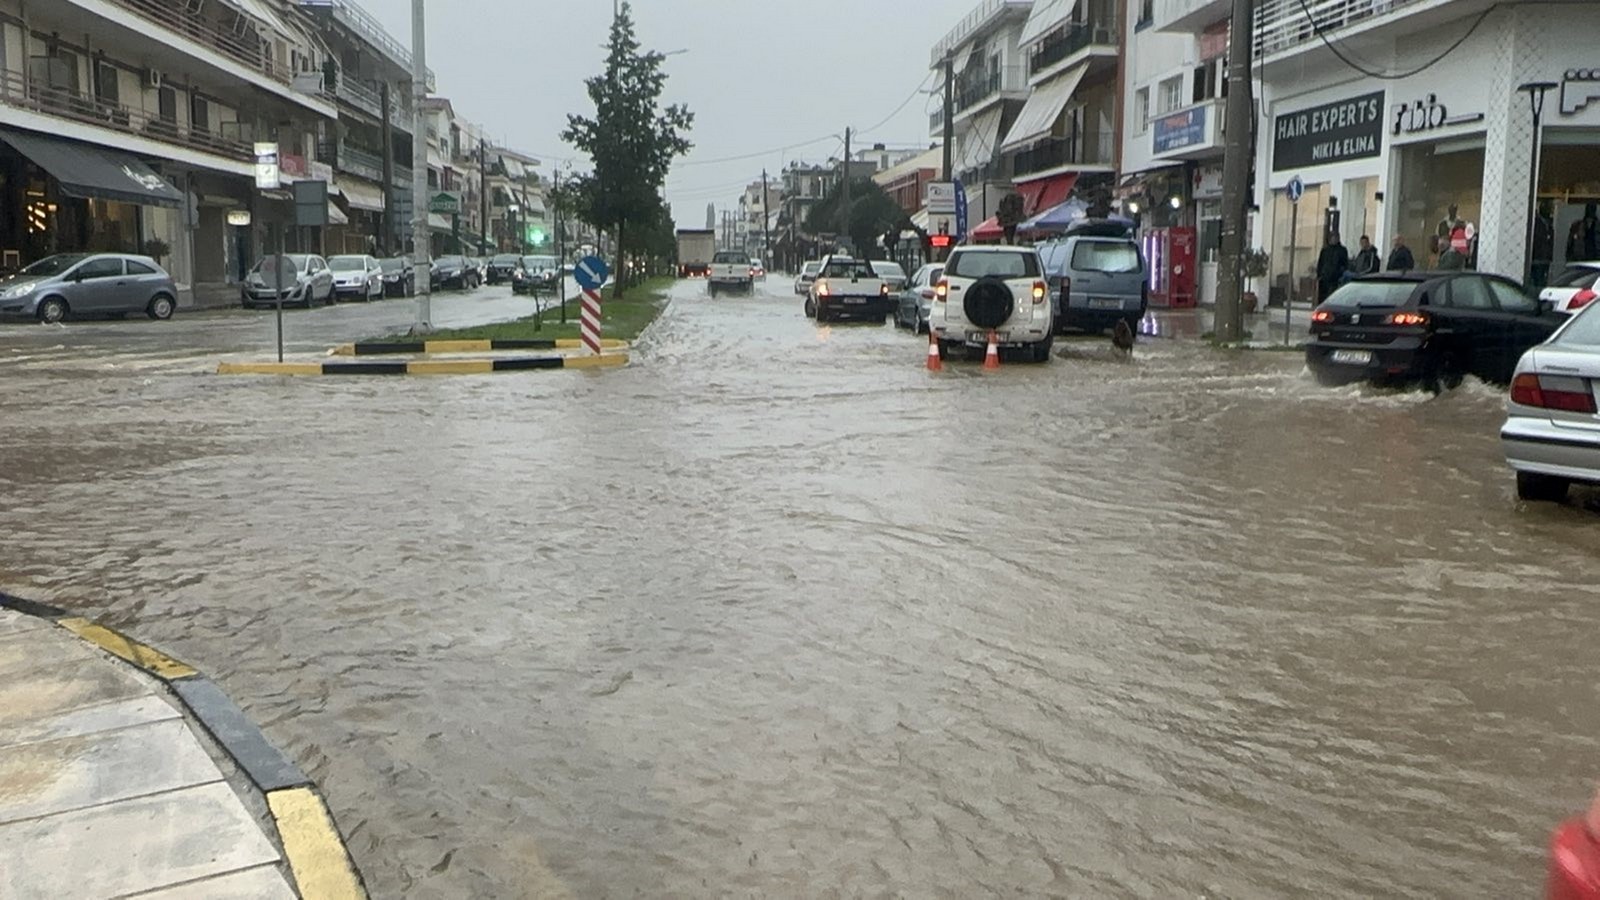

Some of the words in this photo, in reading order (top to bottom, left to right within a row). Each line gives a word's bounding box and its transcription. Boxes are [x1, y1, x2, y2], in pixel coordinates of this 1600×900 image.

[1278, 114, 1307, 140] HAIR
[1312, 98, 1378, 133] EXPERTS
[1312, 141, 1333, 160] NIKI
[1334, 140, 1342, 156] &
[1343, 133, 1375, 155] ELINA
